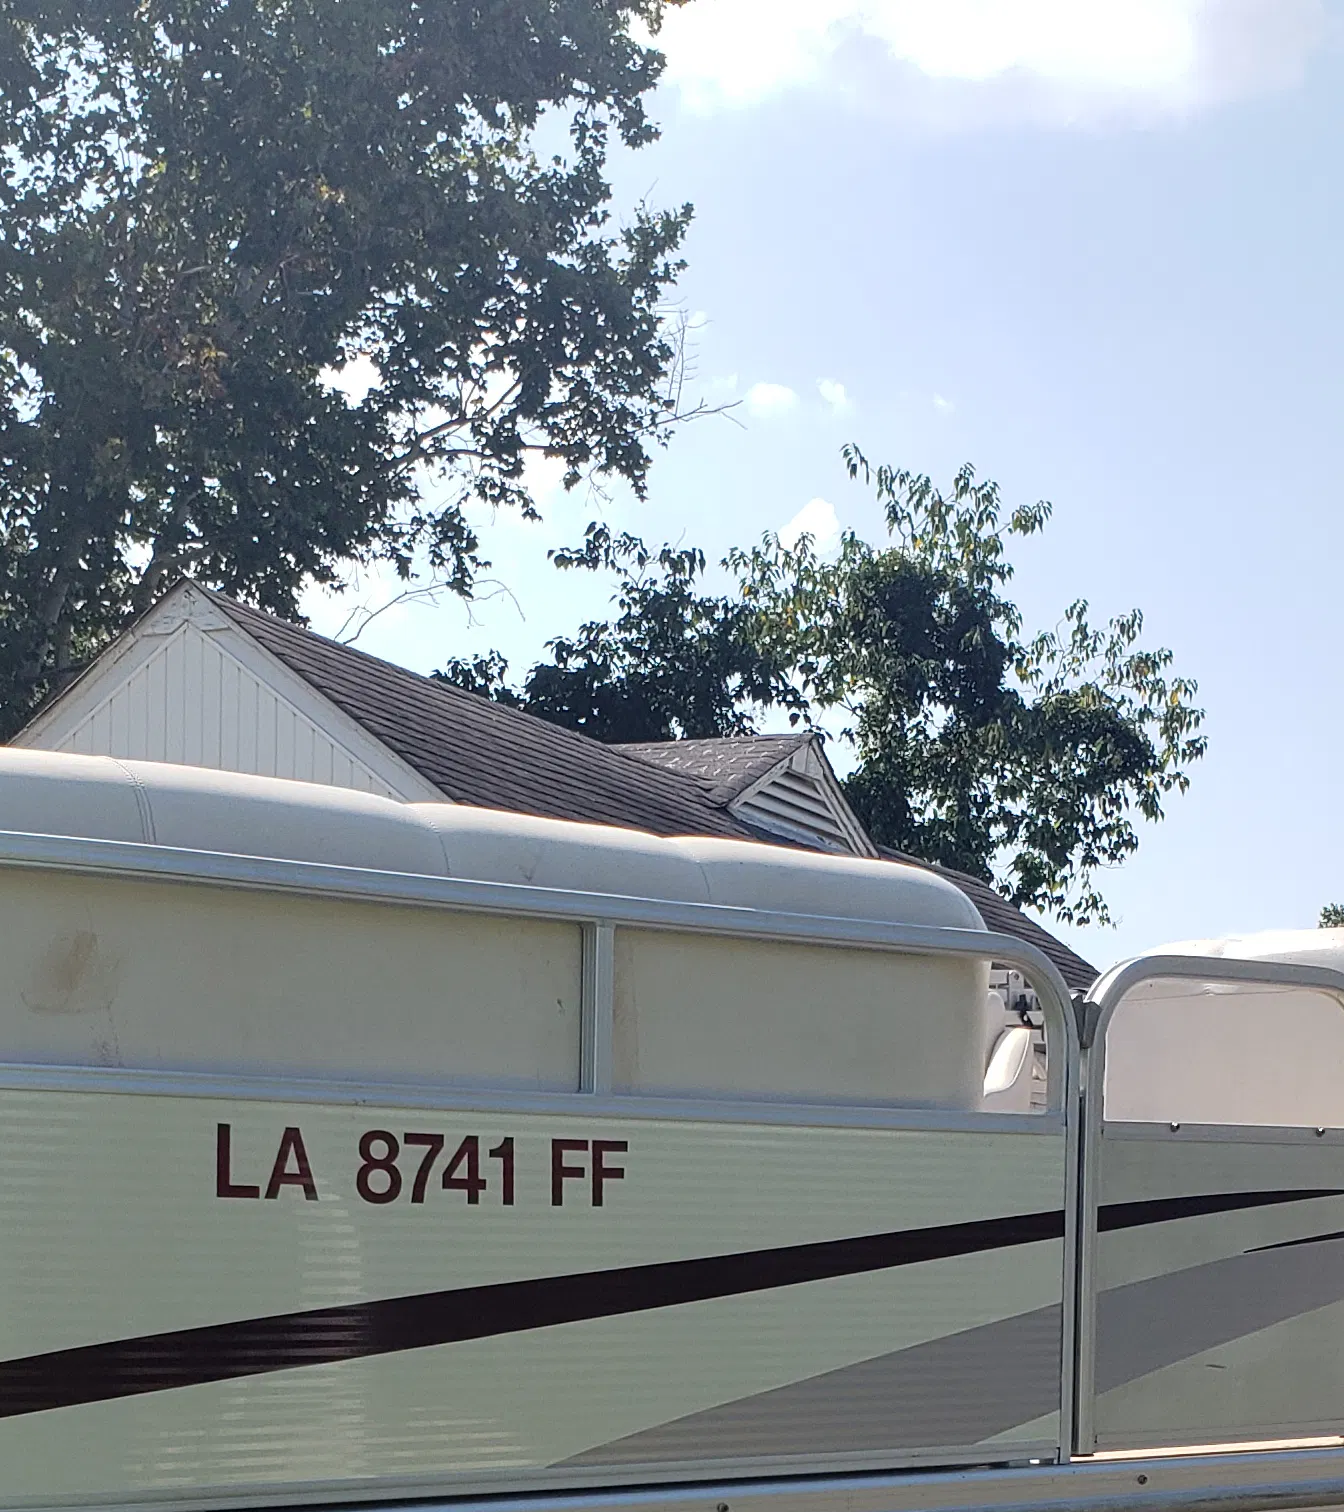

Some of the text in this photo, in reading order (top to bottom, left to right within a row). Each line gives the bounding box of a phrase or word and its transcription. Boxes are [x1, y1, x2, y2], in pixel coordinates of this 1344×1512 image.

[216, 1123, 628, 1207] LA 8741 FF
